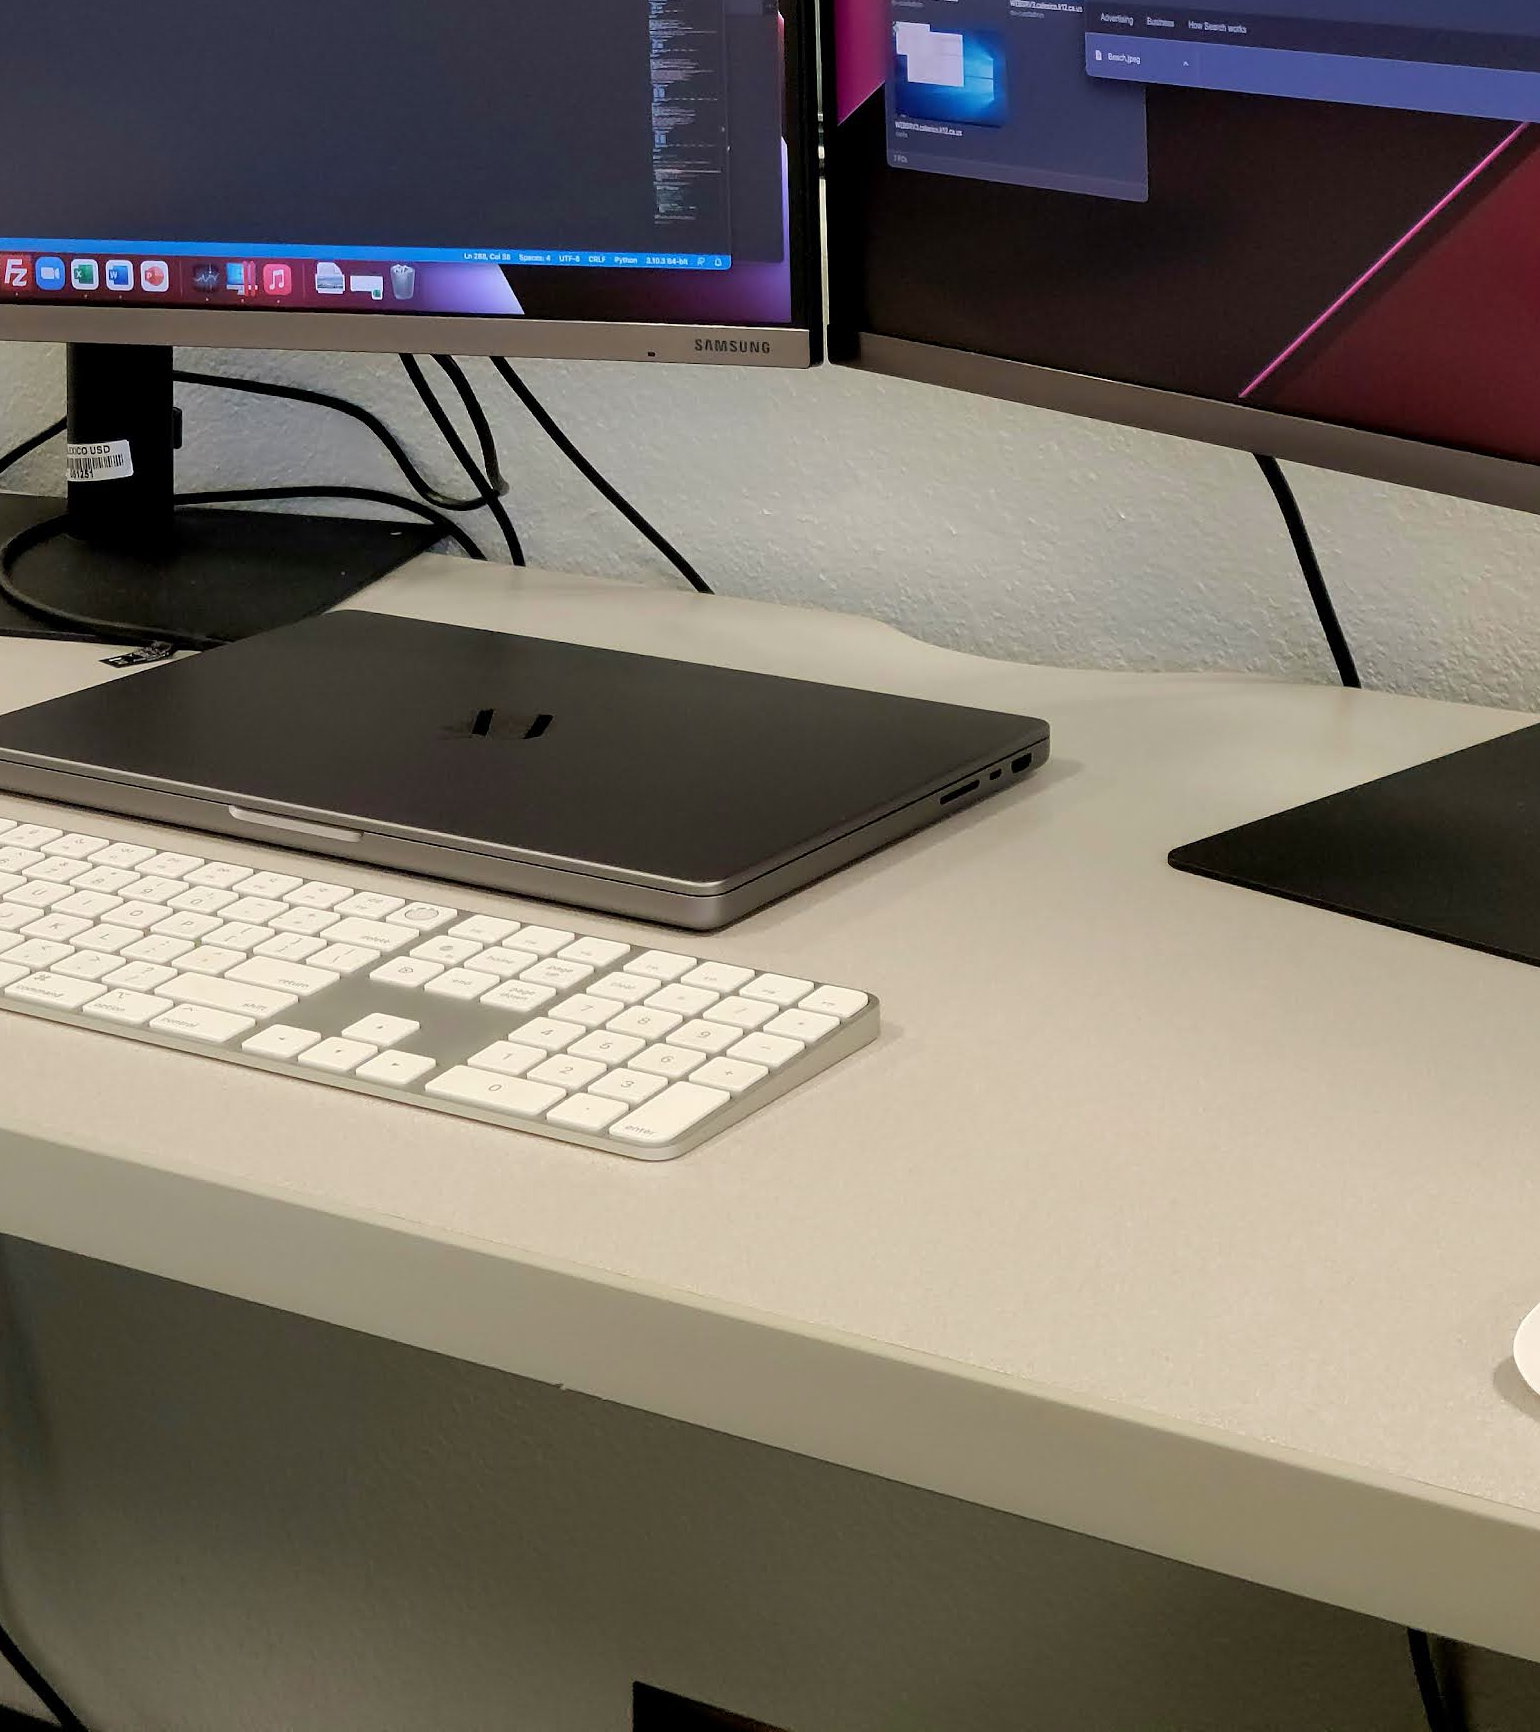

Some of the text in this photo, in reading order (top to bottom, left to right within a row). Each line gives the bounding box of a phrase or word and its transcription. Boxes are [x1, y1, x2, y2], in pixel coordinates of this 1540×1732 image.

[1100, 12, 1134, 26] Advertising
[588, 255, 606, 263] CRLF
[614, 256, 638, 264] Python
[694, 338, 771, 354] SAMSUNG
[90, 445, 111, 455] USD
